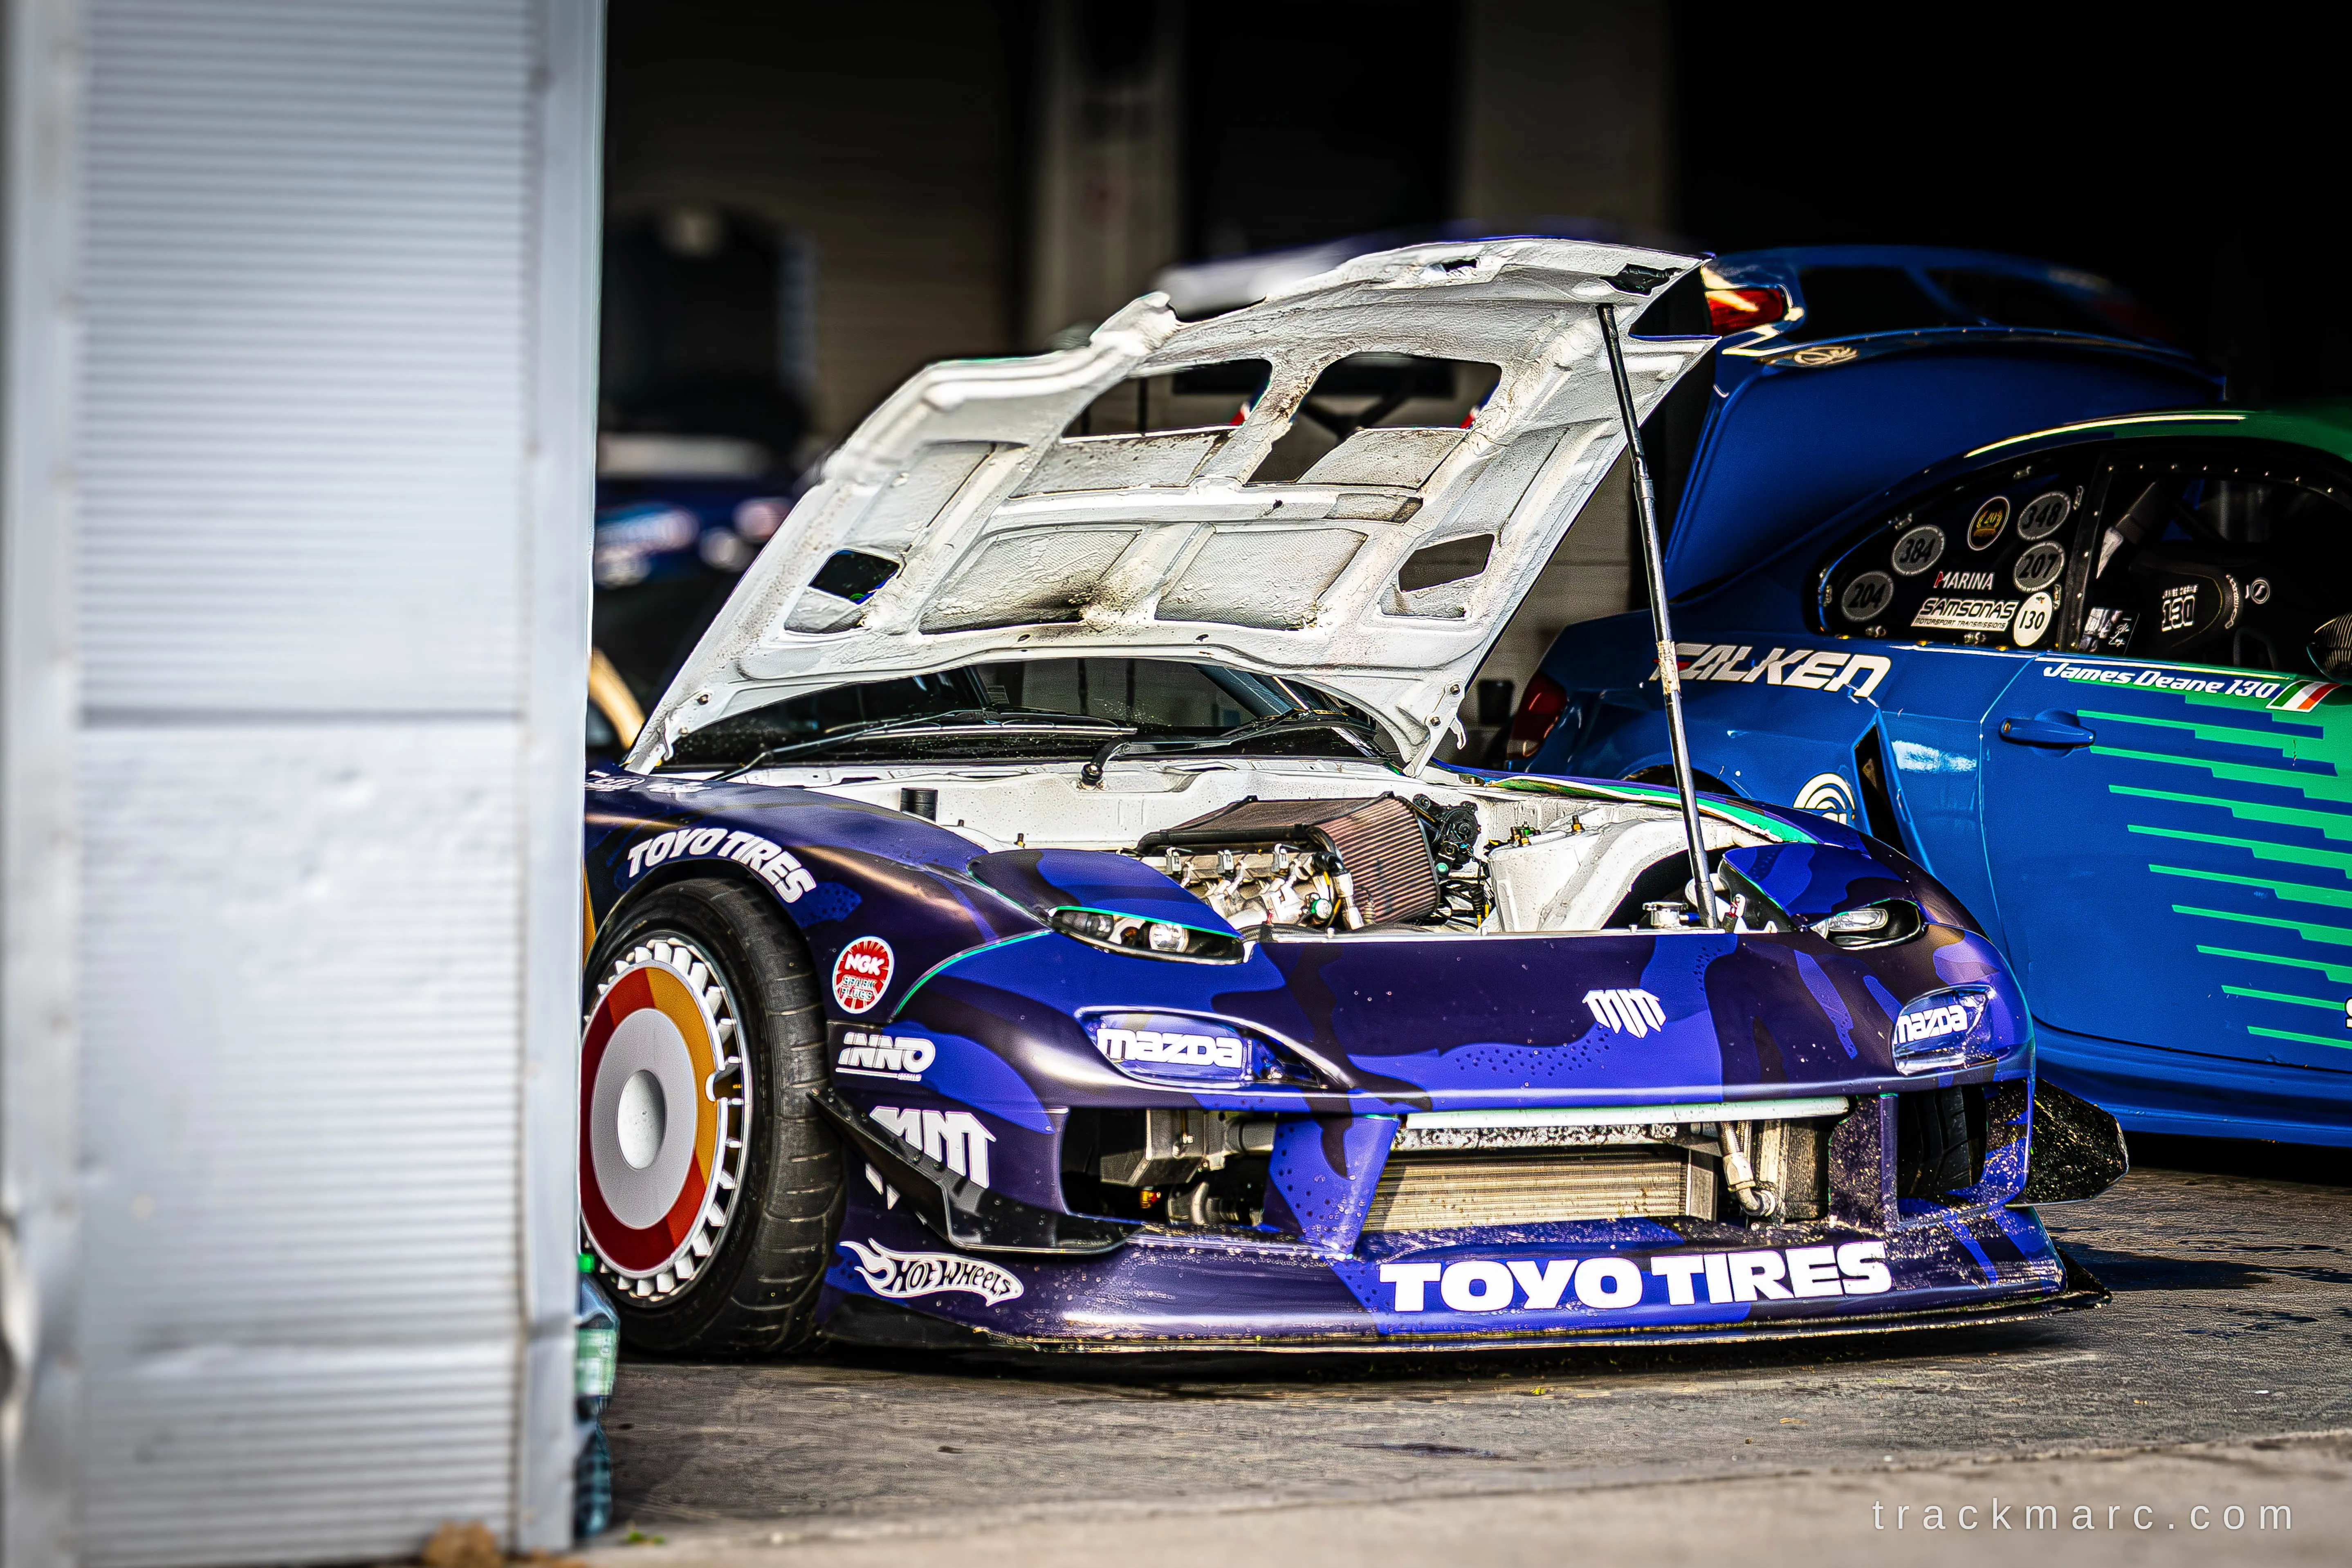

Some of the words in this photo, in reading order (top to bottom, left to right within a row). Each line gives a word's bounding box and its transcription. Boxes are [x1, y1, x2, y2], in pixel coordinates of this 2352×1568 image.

[2022, 502, 2062, 529] 348
[1899, 537, 1936, 563] 384
[2018, 553, 2059, 579] 207
[1933, 571, 1995, 590] MARINA
[1847, 583, 1885, 609] 204
[1919, 598, 2016, 619] SAMSONAS
[1914, 617, 1956, 626] MOTORSPORT
[1957, 620, 2006, 629] TRANSMISSIONS
[2019, 610, 2045, 630] 130
[1649, 643, 1892, 698] FALKEN
[2043, 663, 2136, 684] James
[2134, 671, 2225, 693] Deane
[2225, 679, 2280, 698] 130
[627, 828, 728, 878] TOYO
[717, 830, 817, 903] TIRES
[844, 953, 885, 976] NGK
[839, 987, 873, 1000] PLUGS
[843, 975, 878, 989] SPARK
[838, 1032, 936, 1073] INNO
[1379, 1257, 1643, 1312] TOYO
[1650, 1241, 1892, 1306] TIRES
